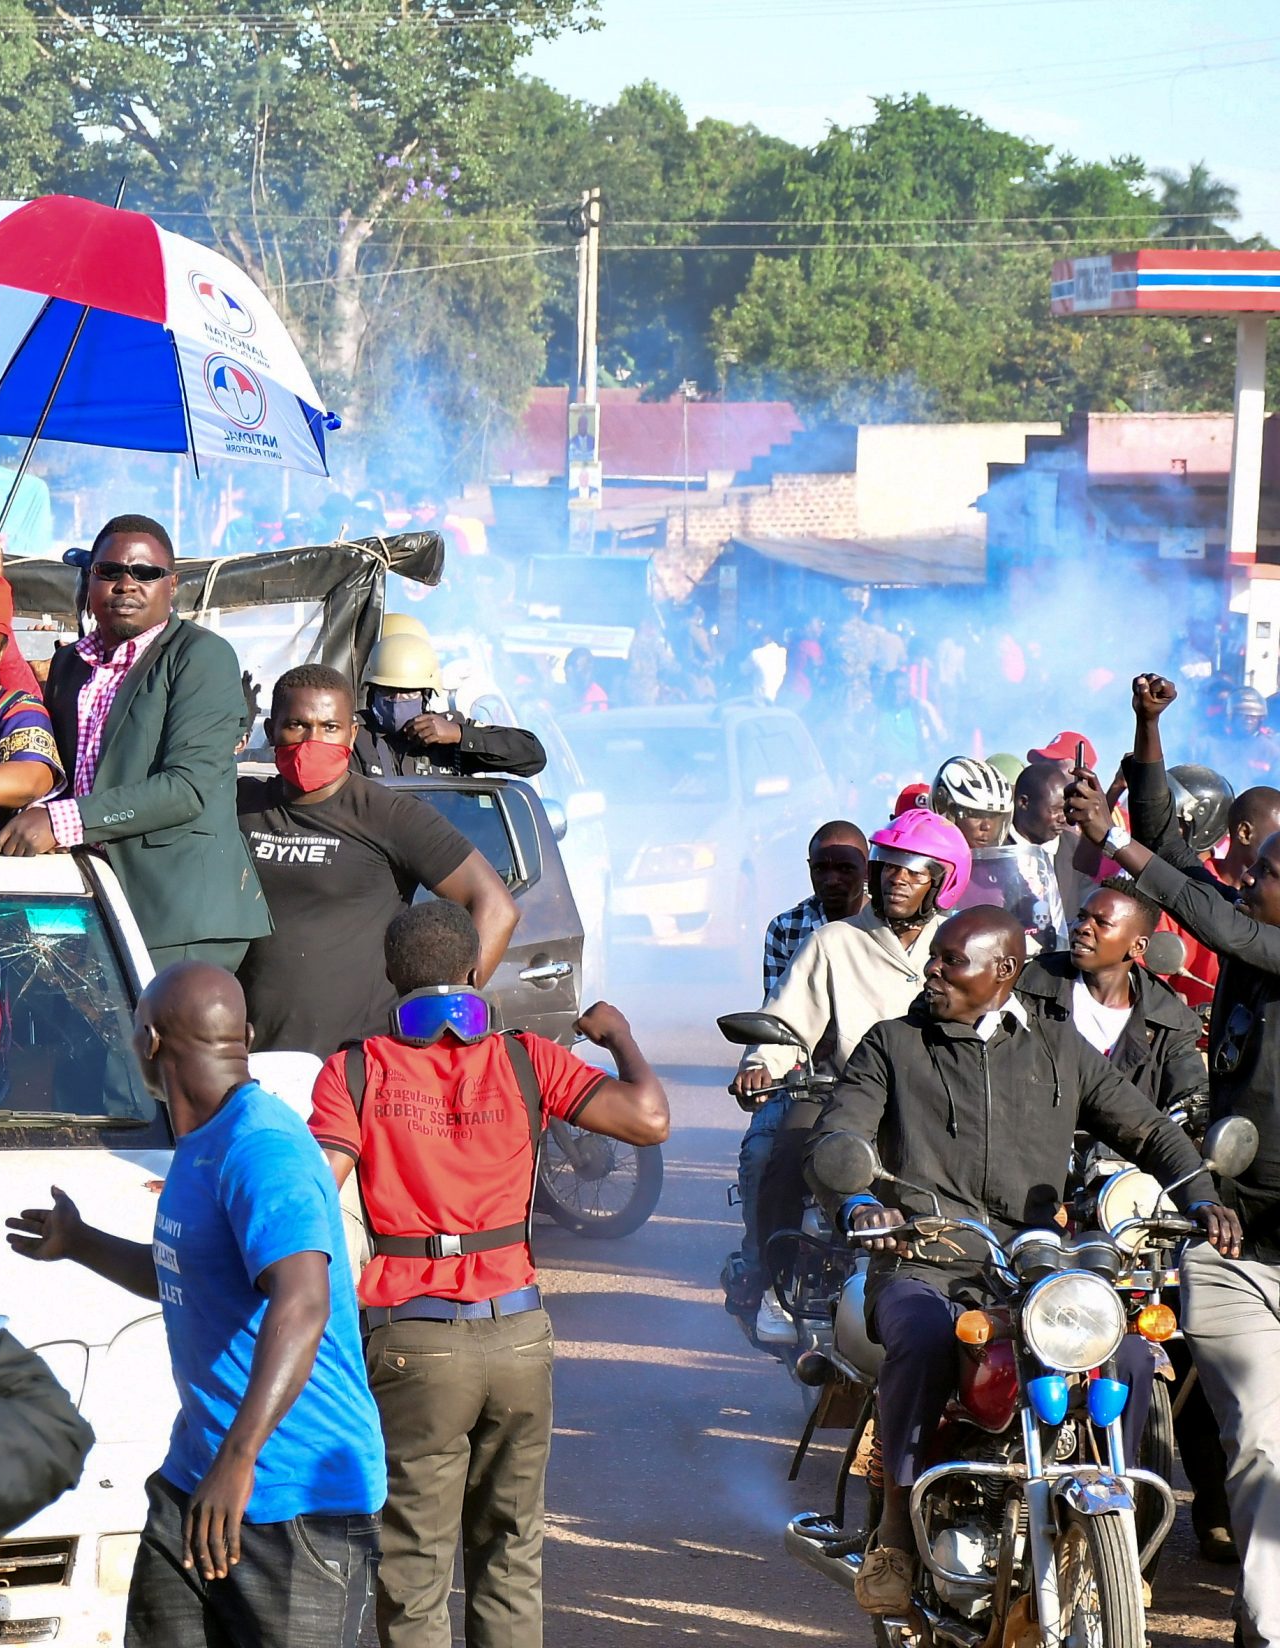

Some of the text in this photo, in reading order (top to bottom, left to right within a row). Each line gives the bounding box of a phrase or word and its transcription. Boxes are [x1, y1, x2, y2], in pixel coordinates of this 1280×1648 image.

[204, 322, 269, 361] NATIONAL
[375, 1088, 446, 1110] Kyagulanyi
[374, 1103, 505, 1127] ROBERT SSENTAMU
[158, 1281, 183, 1306] LLET
